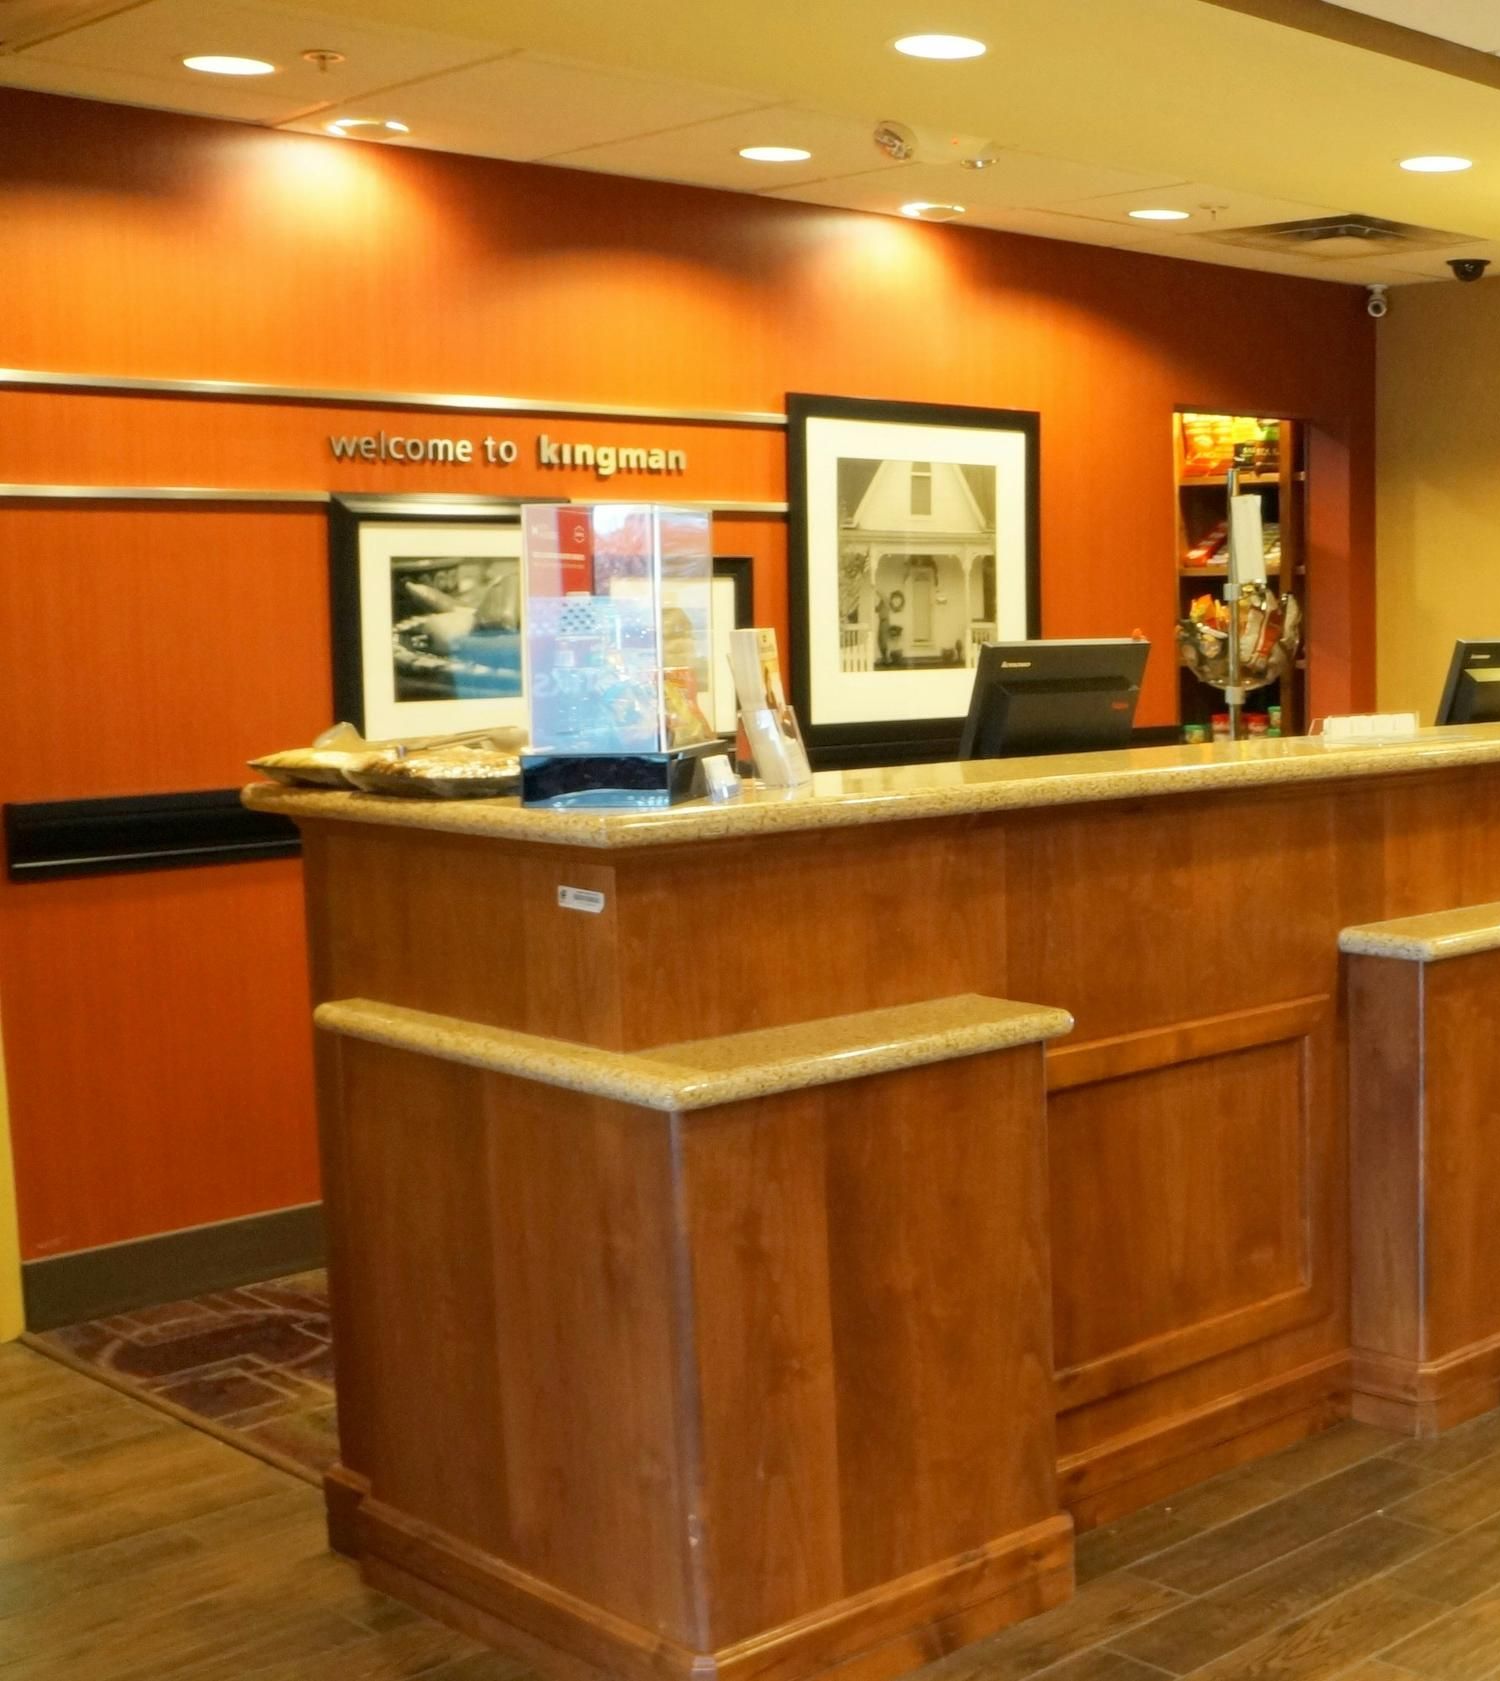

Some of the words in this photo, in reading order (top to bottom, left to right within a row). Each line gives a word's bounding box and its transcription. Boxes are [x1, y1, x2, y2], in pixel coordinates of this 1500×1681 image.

[330, 431, 473, 462] welcome
[484, 436, 518, 463] to
[539, 434, 687, 476] kingman
